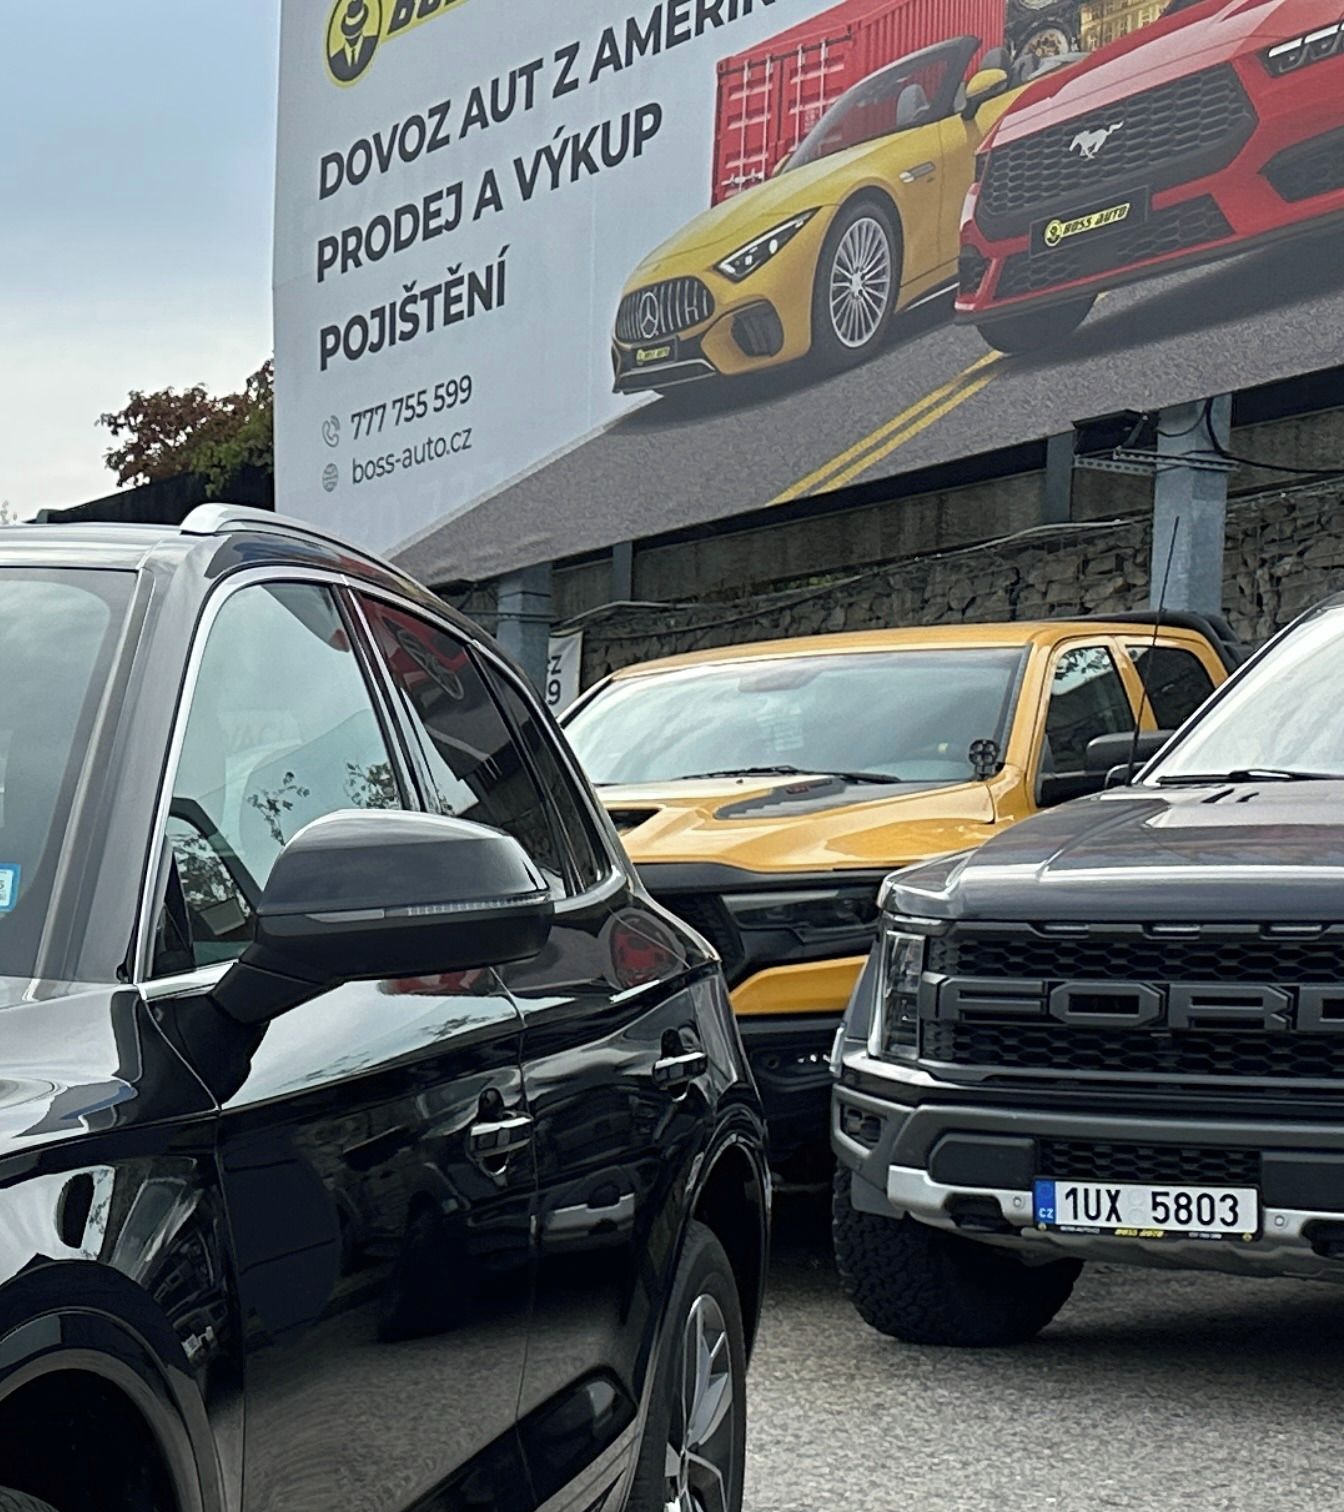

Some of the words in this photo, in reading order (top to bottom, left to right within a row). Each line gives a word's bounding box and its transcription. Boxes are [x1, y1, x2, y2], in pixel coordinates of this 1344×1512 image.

[318, 99, 452, 201] DOVOZ
[458, 58, 544, 138] AUT
[552, 42, 580, 99] Z
[316, 180, 464, 283] PRODEJ
[472, 168, 505, 221] A
[514, 102, 663, 203] VÝKUP
[1062, 216, 1093, 236] BOSS
[1095, 205, 1128, 226] AUTO
[319, 245, 511, 372] POJIŠTĚNÍ
[350, 402, 387, 441] 777
[392, 389, 428, 427] 755
[432, 374, 473, 413] 599
[352, 427, 473, 485] boss-auto.cz
[1038, 1207, 1054, 1219] CZ
[1064, 1186, 1123, 1223] 1UX
[1150, 1190, 1240, 1227] 5803
